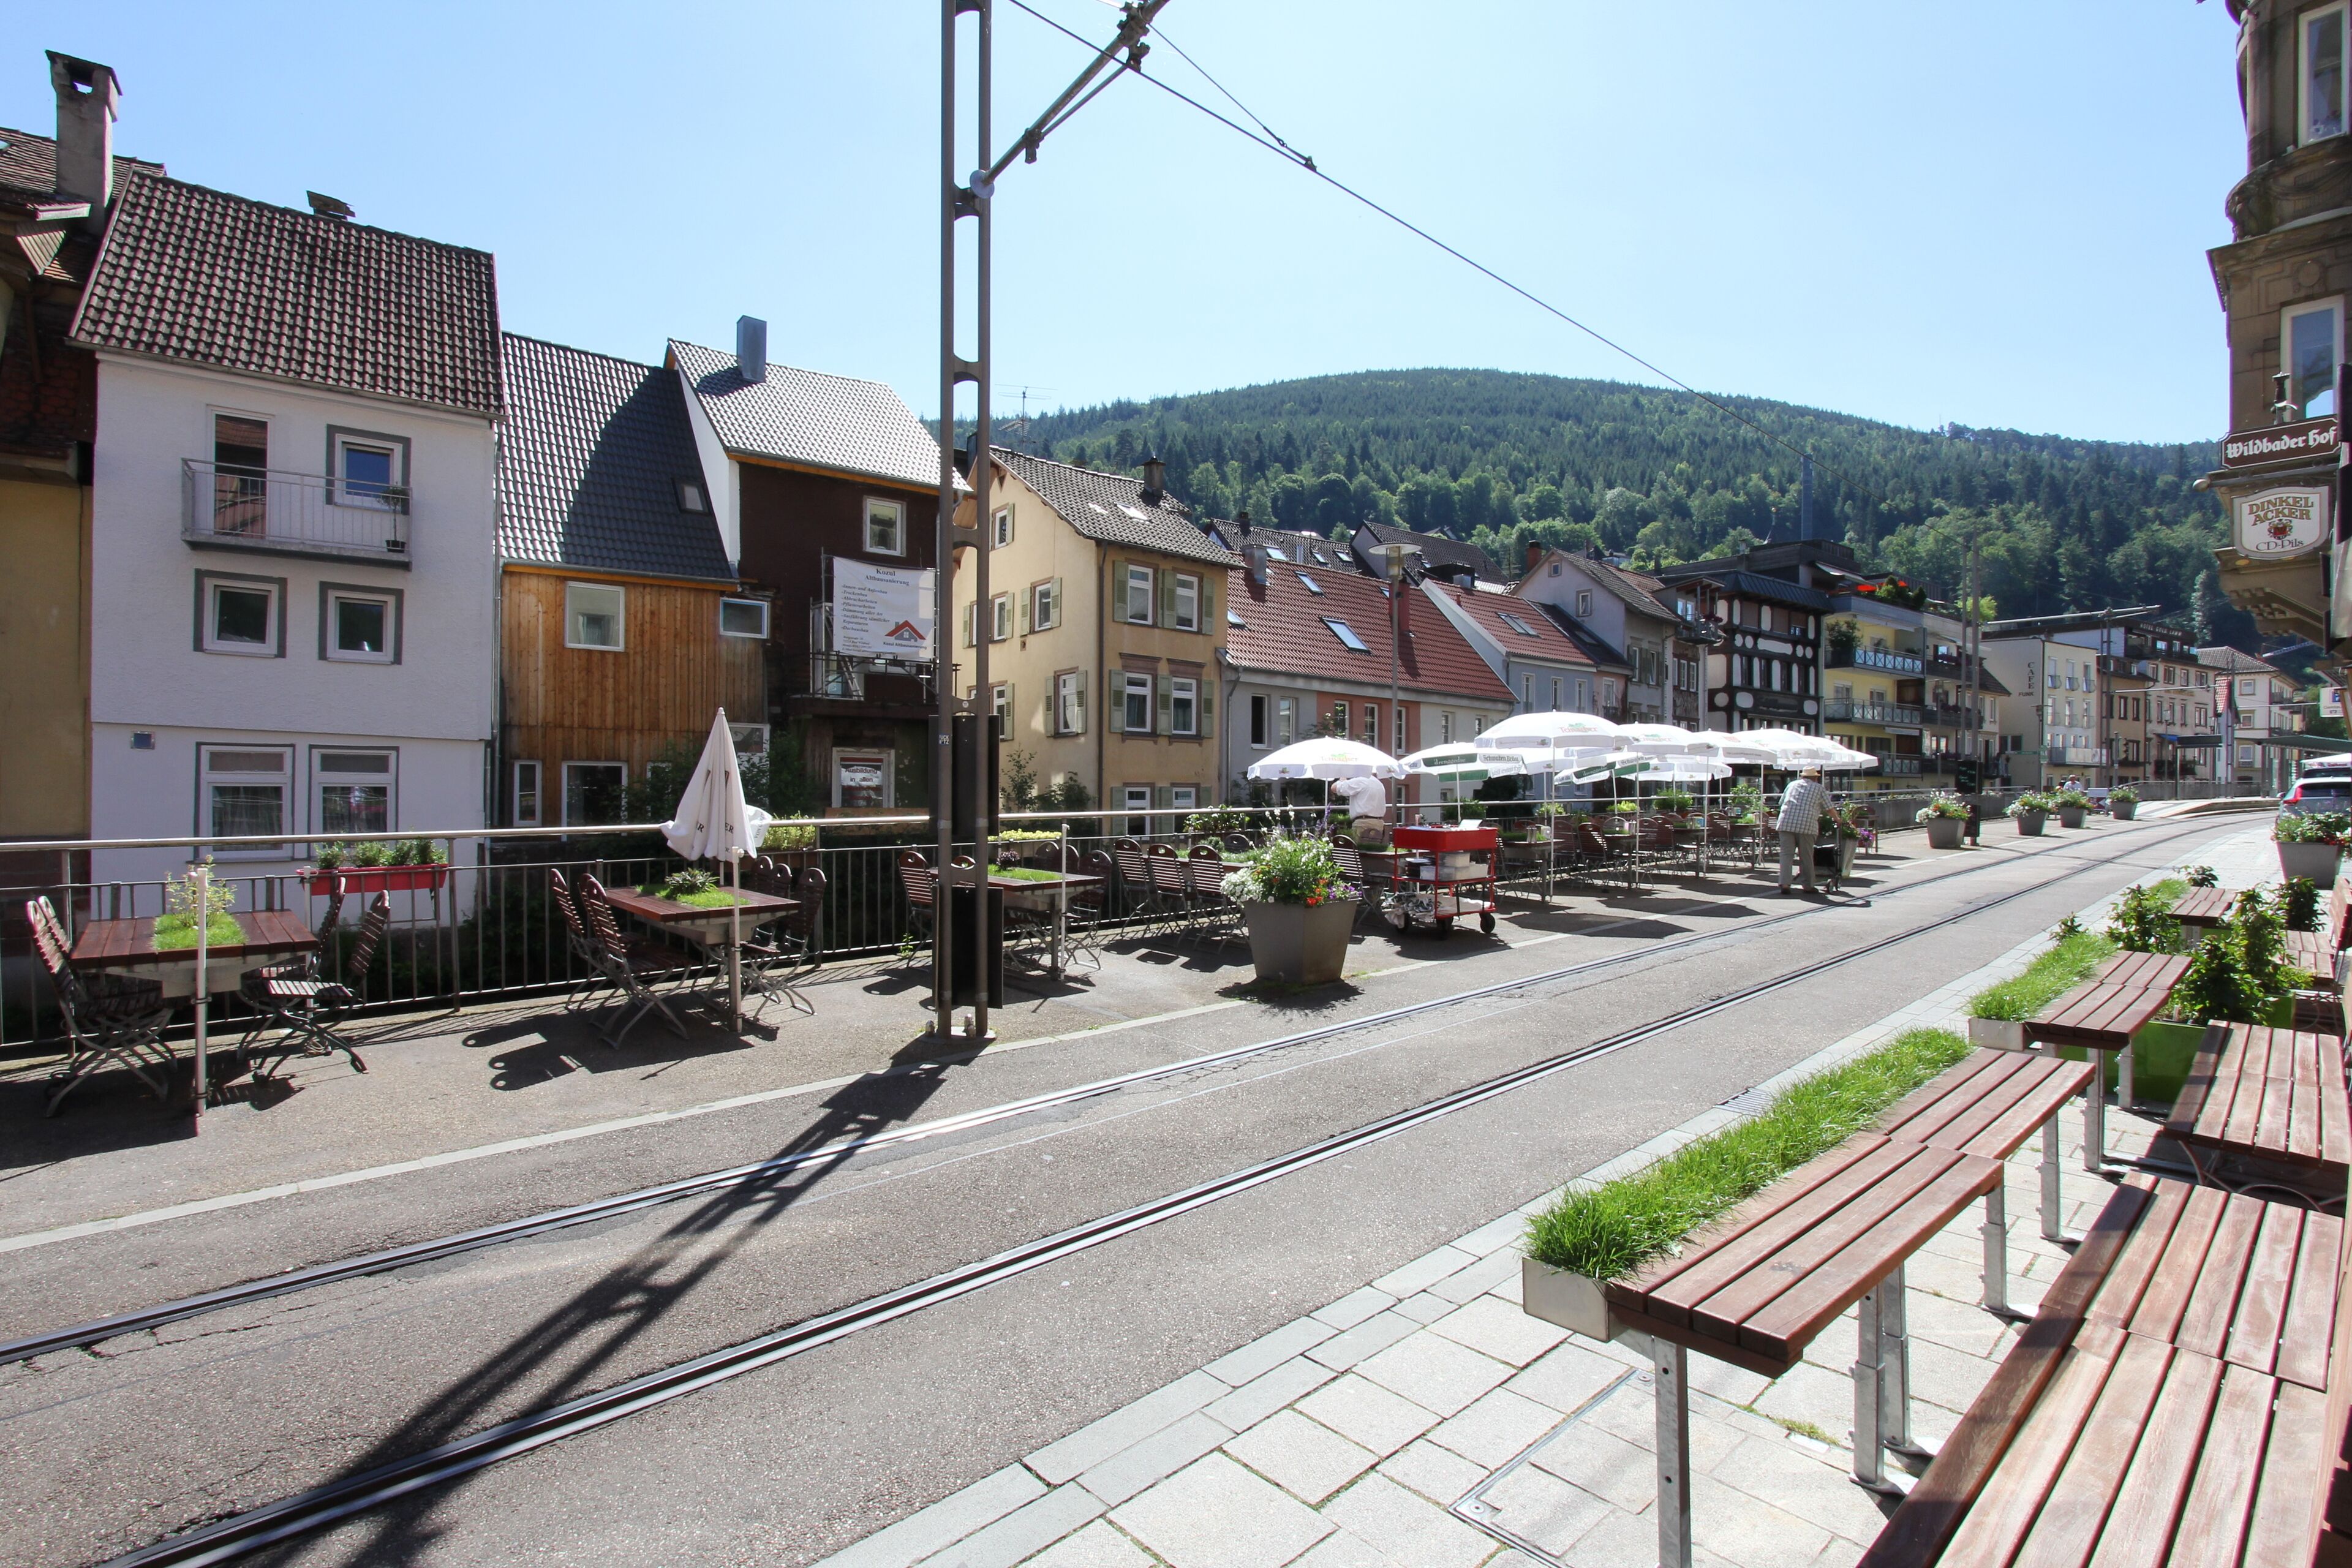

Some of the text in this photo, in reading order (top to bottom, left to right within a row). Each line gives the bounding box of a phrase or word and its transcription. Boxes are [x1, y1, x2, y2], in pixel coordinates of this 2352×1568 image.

[2226, 426, 2337, 459] Wildbader Hof
[2248, 495, 2313, 516] DINKEL
[2252, 508, 2312, 527] ACKER
[2256, 538, 2304, 552] CD-Pils
[865, 575, 910, 586] Altbausanierung
